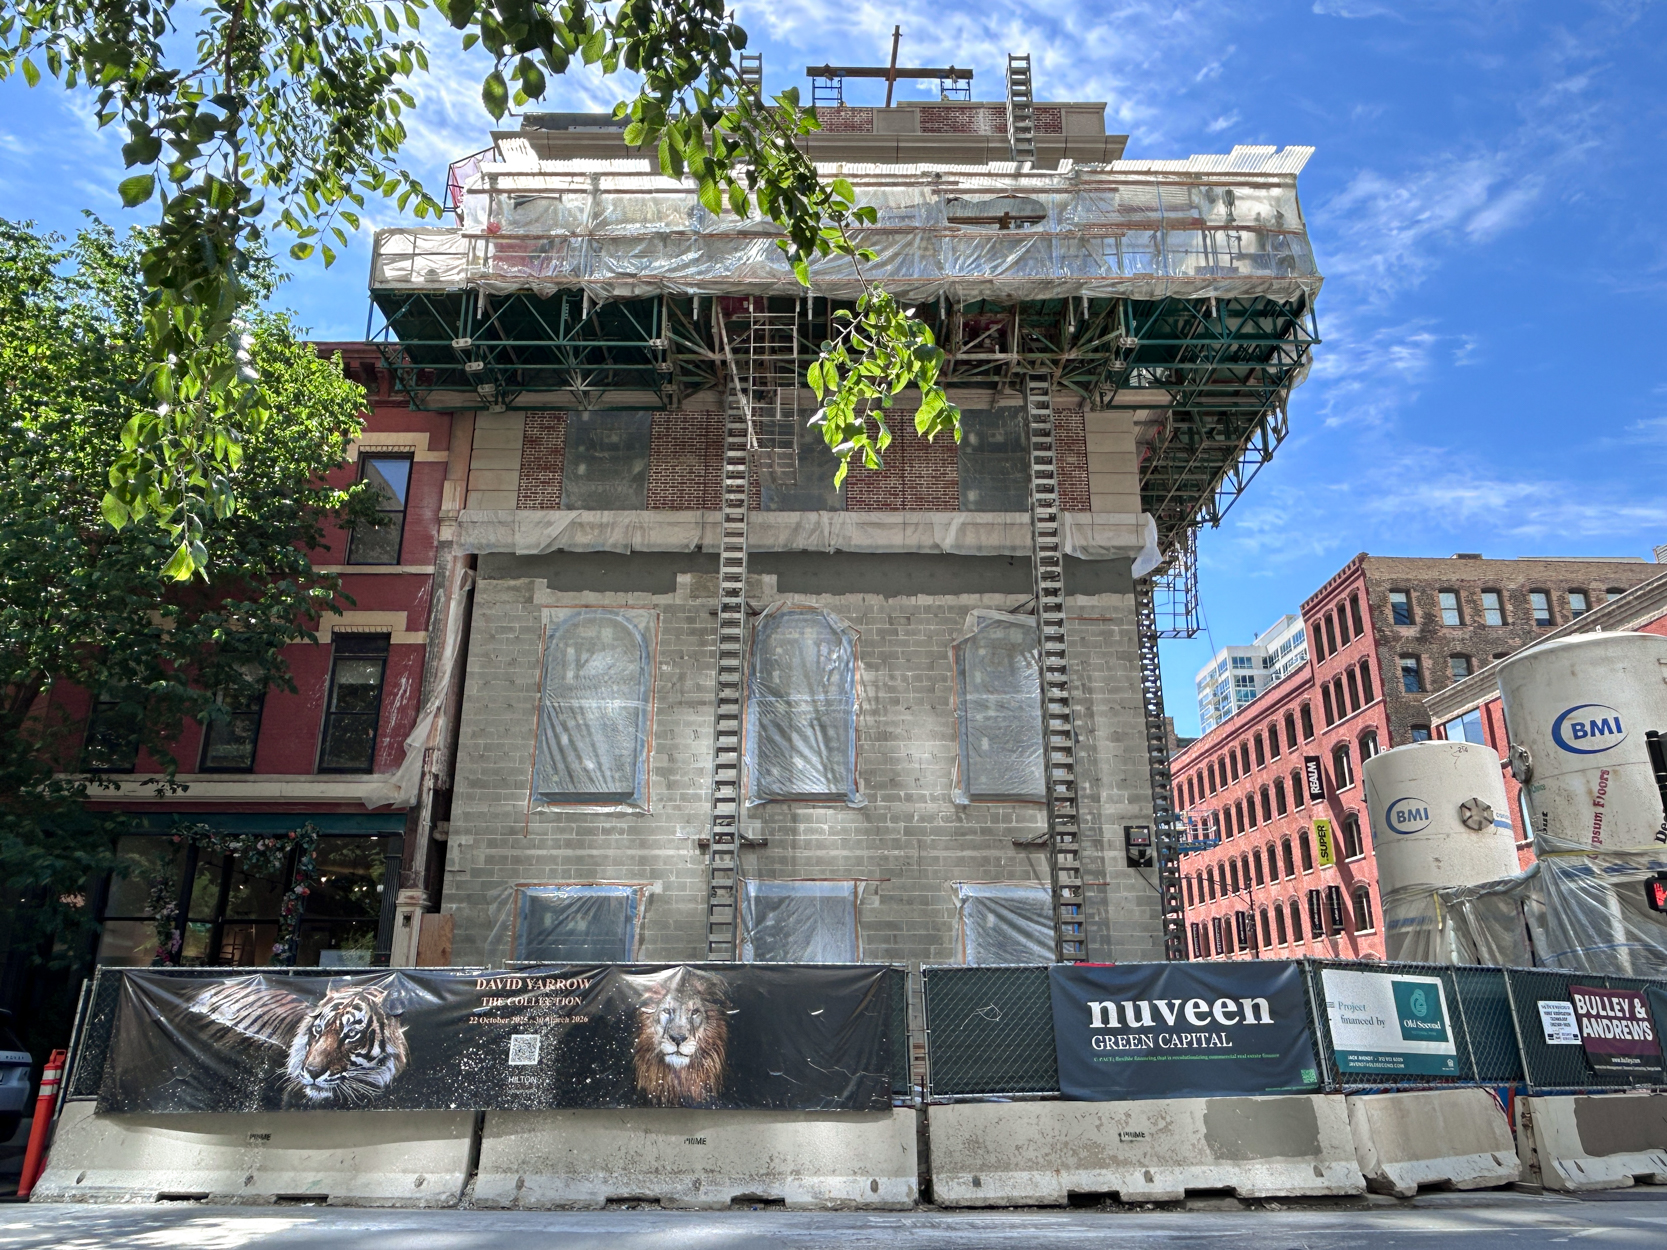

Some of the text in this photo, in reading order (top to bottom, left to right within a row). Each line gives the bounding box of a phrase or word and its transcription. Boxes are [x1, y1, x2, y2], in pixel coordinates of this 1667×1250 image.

[1571, 716, 1623, 740] BMI
[1306, 761, 1322, 794] REALM
[1592, 769, 1610, 808] Floors
[1396, 807, 1429, 824] BMI
[1316, 825, 1329, 861] .SUPER
[475, 978, 593, 990] DAVID YARROW
[481, 997, 582, 1006] THE COLLECTION
[1338, 1001, 1366, 1012] Project
[1573, 994, 1648, 1019] BULLEY &
[468, 1016, 478, 1024] 22
[479, 1016, 510, 1024] October
[510, 1016, 528, 1024] 2025
[571, 1015, 589, 1023] 2026
[1087, 996, 1275, 1028] nuveen
[1340, 1015, 1386, 1028] financed by
[1403, 1019, 1442, 1030] Old Second
[1582, 1017, 1653, 1041] ANDREWS
[1091, 1032, 1233, 1050] GREEN CAPITAL
[508, 1075, 537, 1084] HILTON
